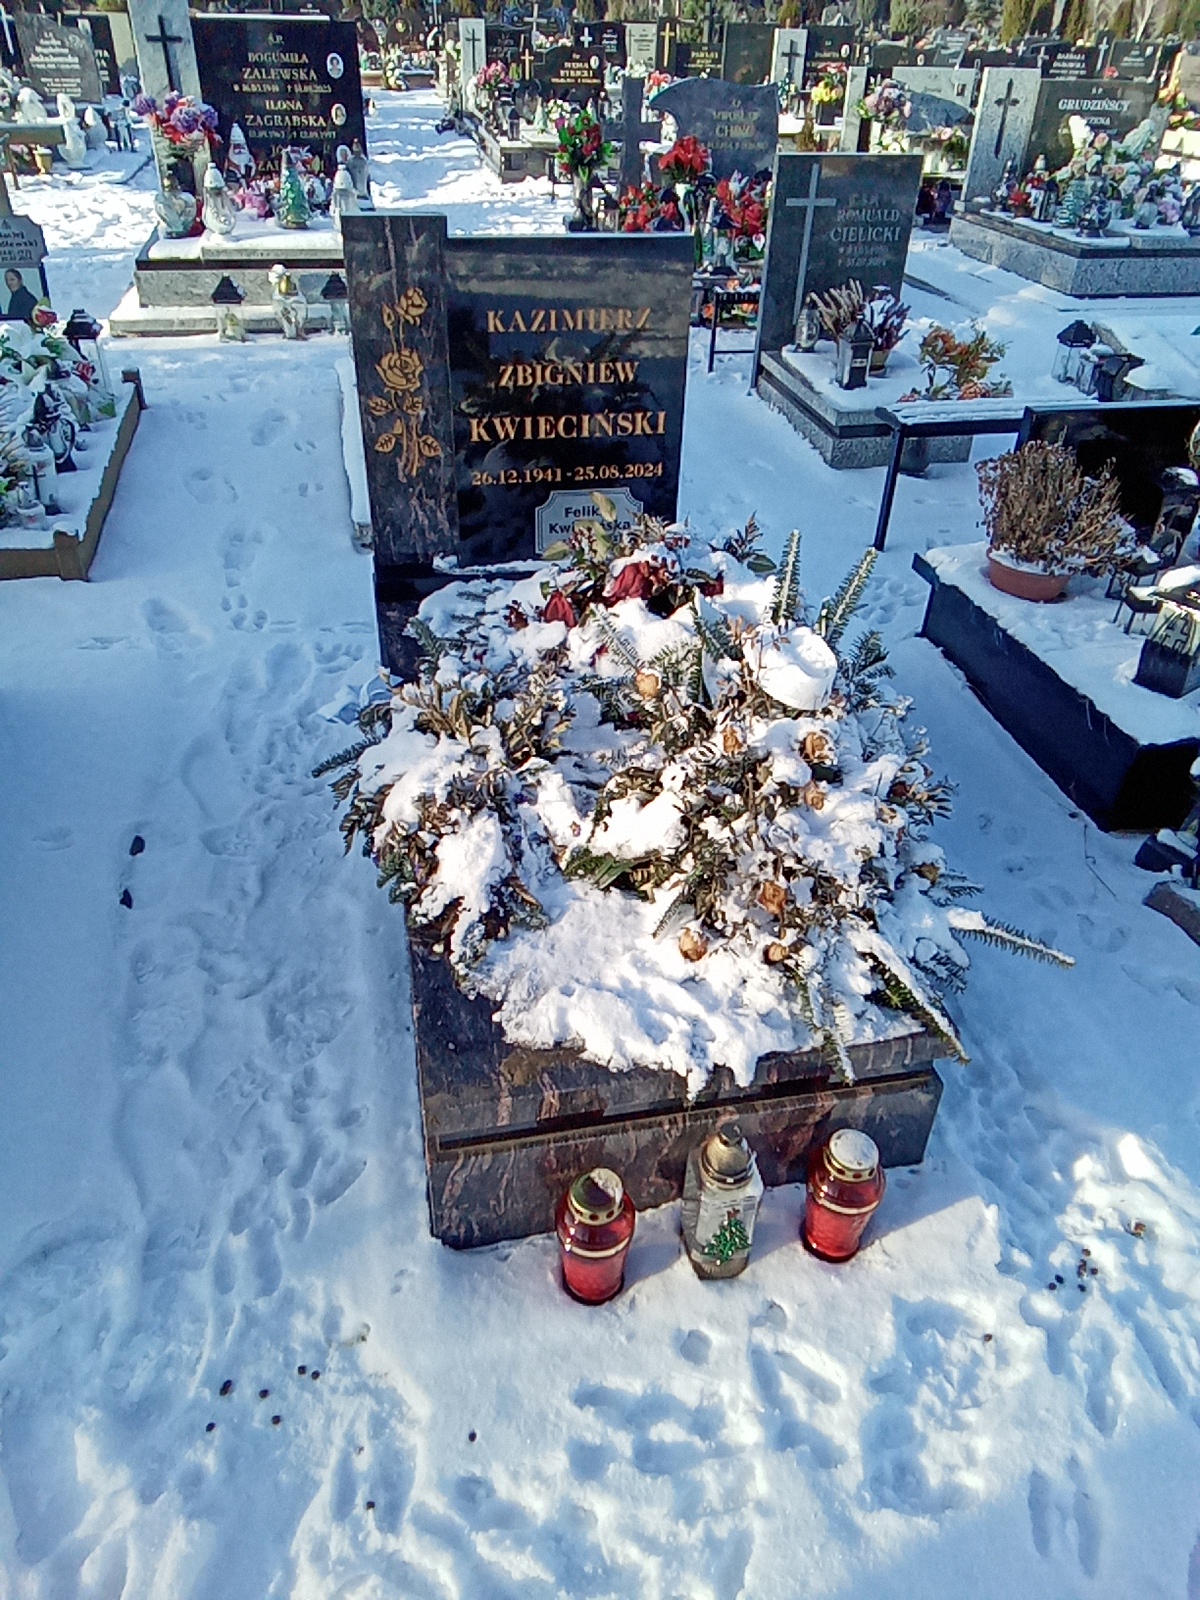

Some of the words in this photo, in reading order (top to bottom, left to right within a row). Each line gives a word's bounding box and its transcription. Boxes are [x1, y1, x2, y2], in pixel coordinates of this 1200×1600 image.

[241, 67, 318, 81] ZALEWSKA
[264, 100, 304, 111] ILONA
[1058, 97, 1131, 111] GRUDZIŃSCY
[837, 208, 900, 221] ROMUALD
[830, 226, 901, 242] CIELICKI
[487, 307, 651, 333] KAZIMIERZ
[499, 361, 640, 388] ZBIGNIEW
[469, 408, 667, 442] KWIECIŃSKI
[471, 467, 562, 486] 26.12.1941
[574, 462, 664, 480] 25.08.2024
